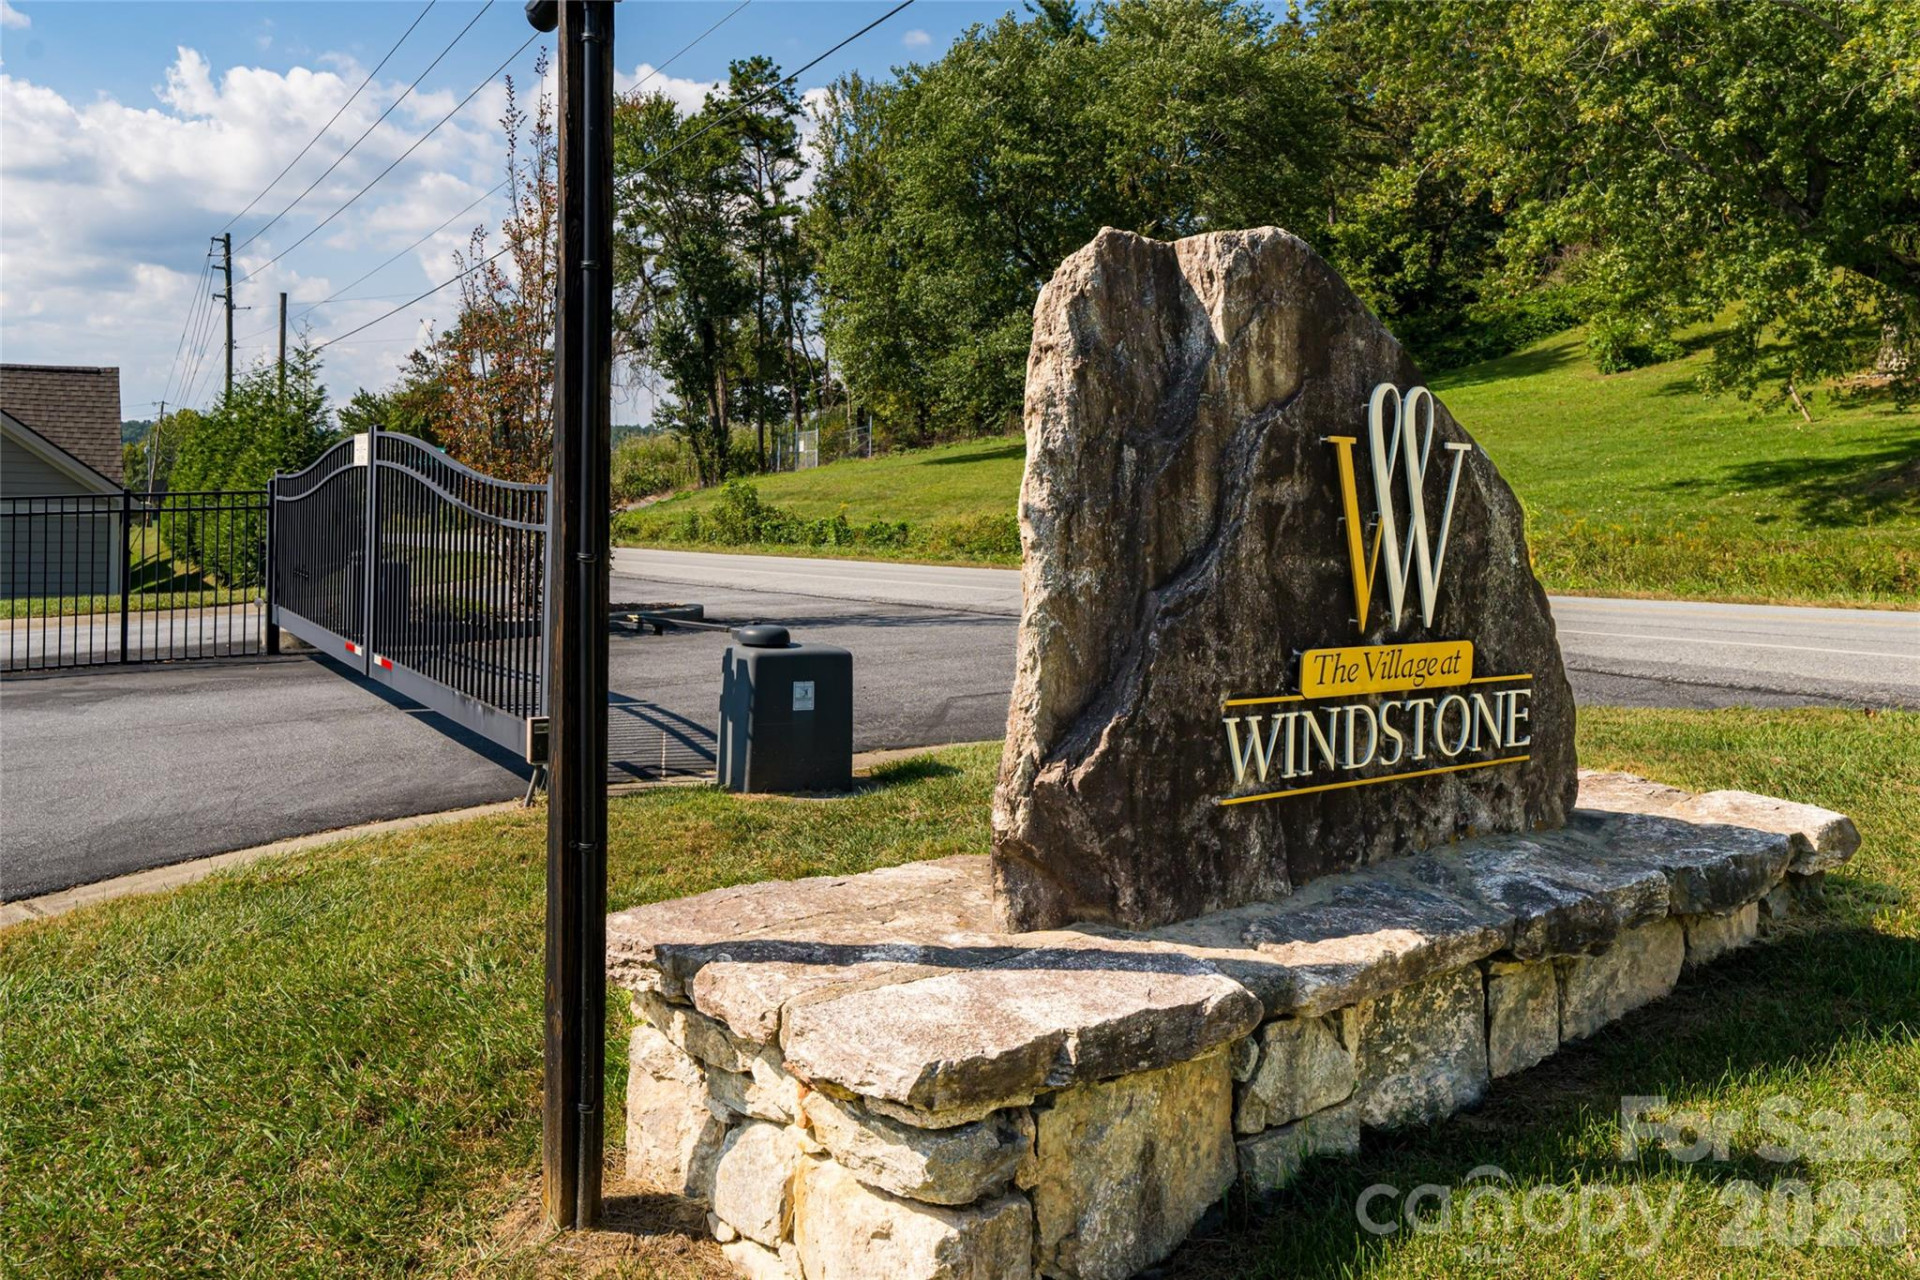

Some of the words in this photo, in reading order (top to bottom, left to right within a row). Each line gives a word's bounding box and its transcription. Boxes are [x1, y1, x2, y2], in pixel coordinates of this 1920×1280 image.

[1314, 653, 1359, 685] The
[1363, 649, 1436, 687] Village
[1440, 650, 1462, 675] at
[1222, 689, 1532, 785] WINDSTONE
